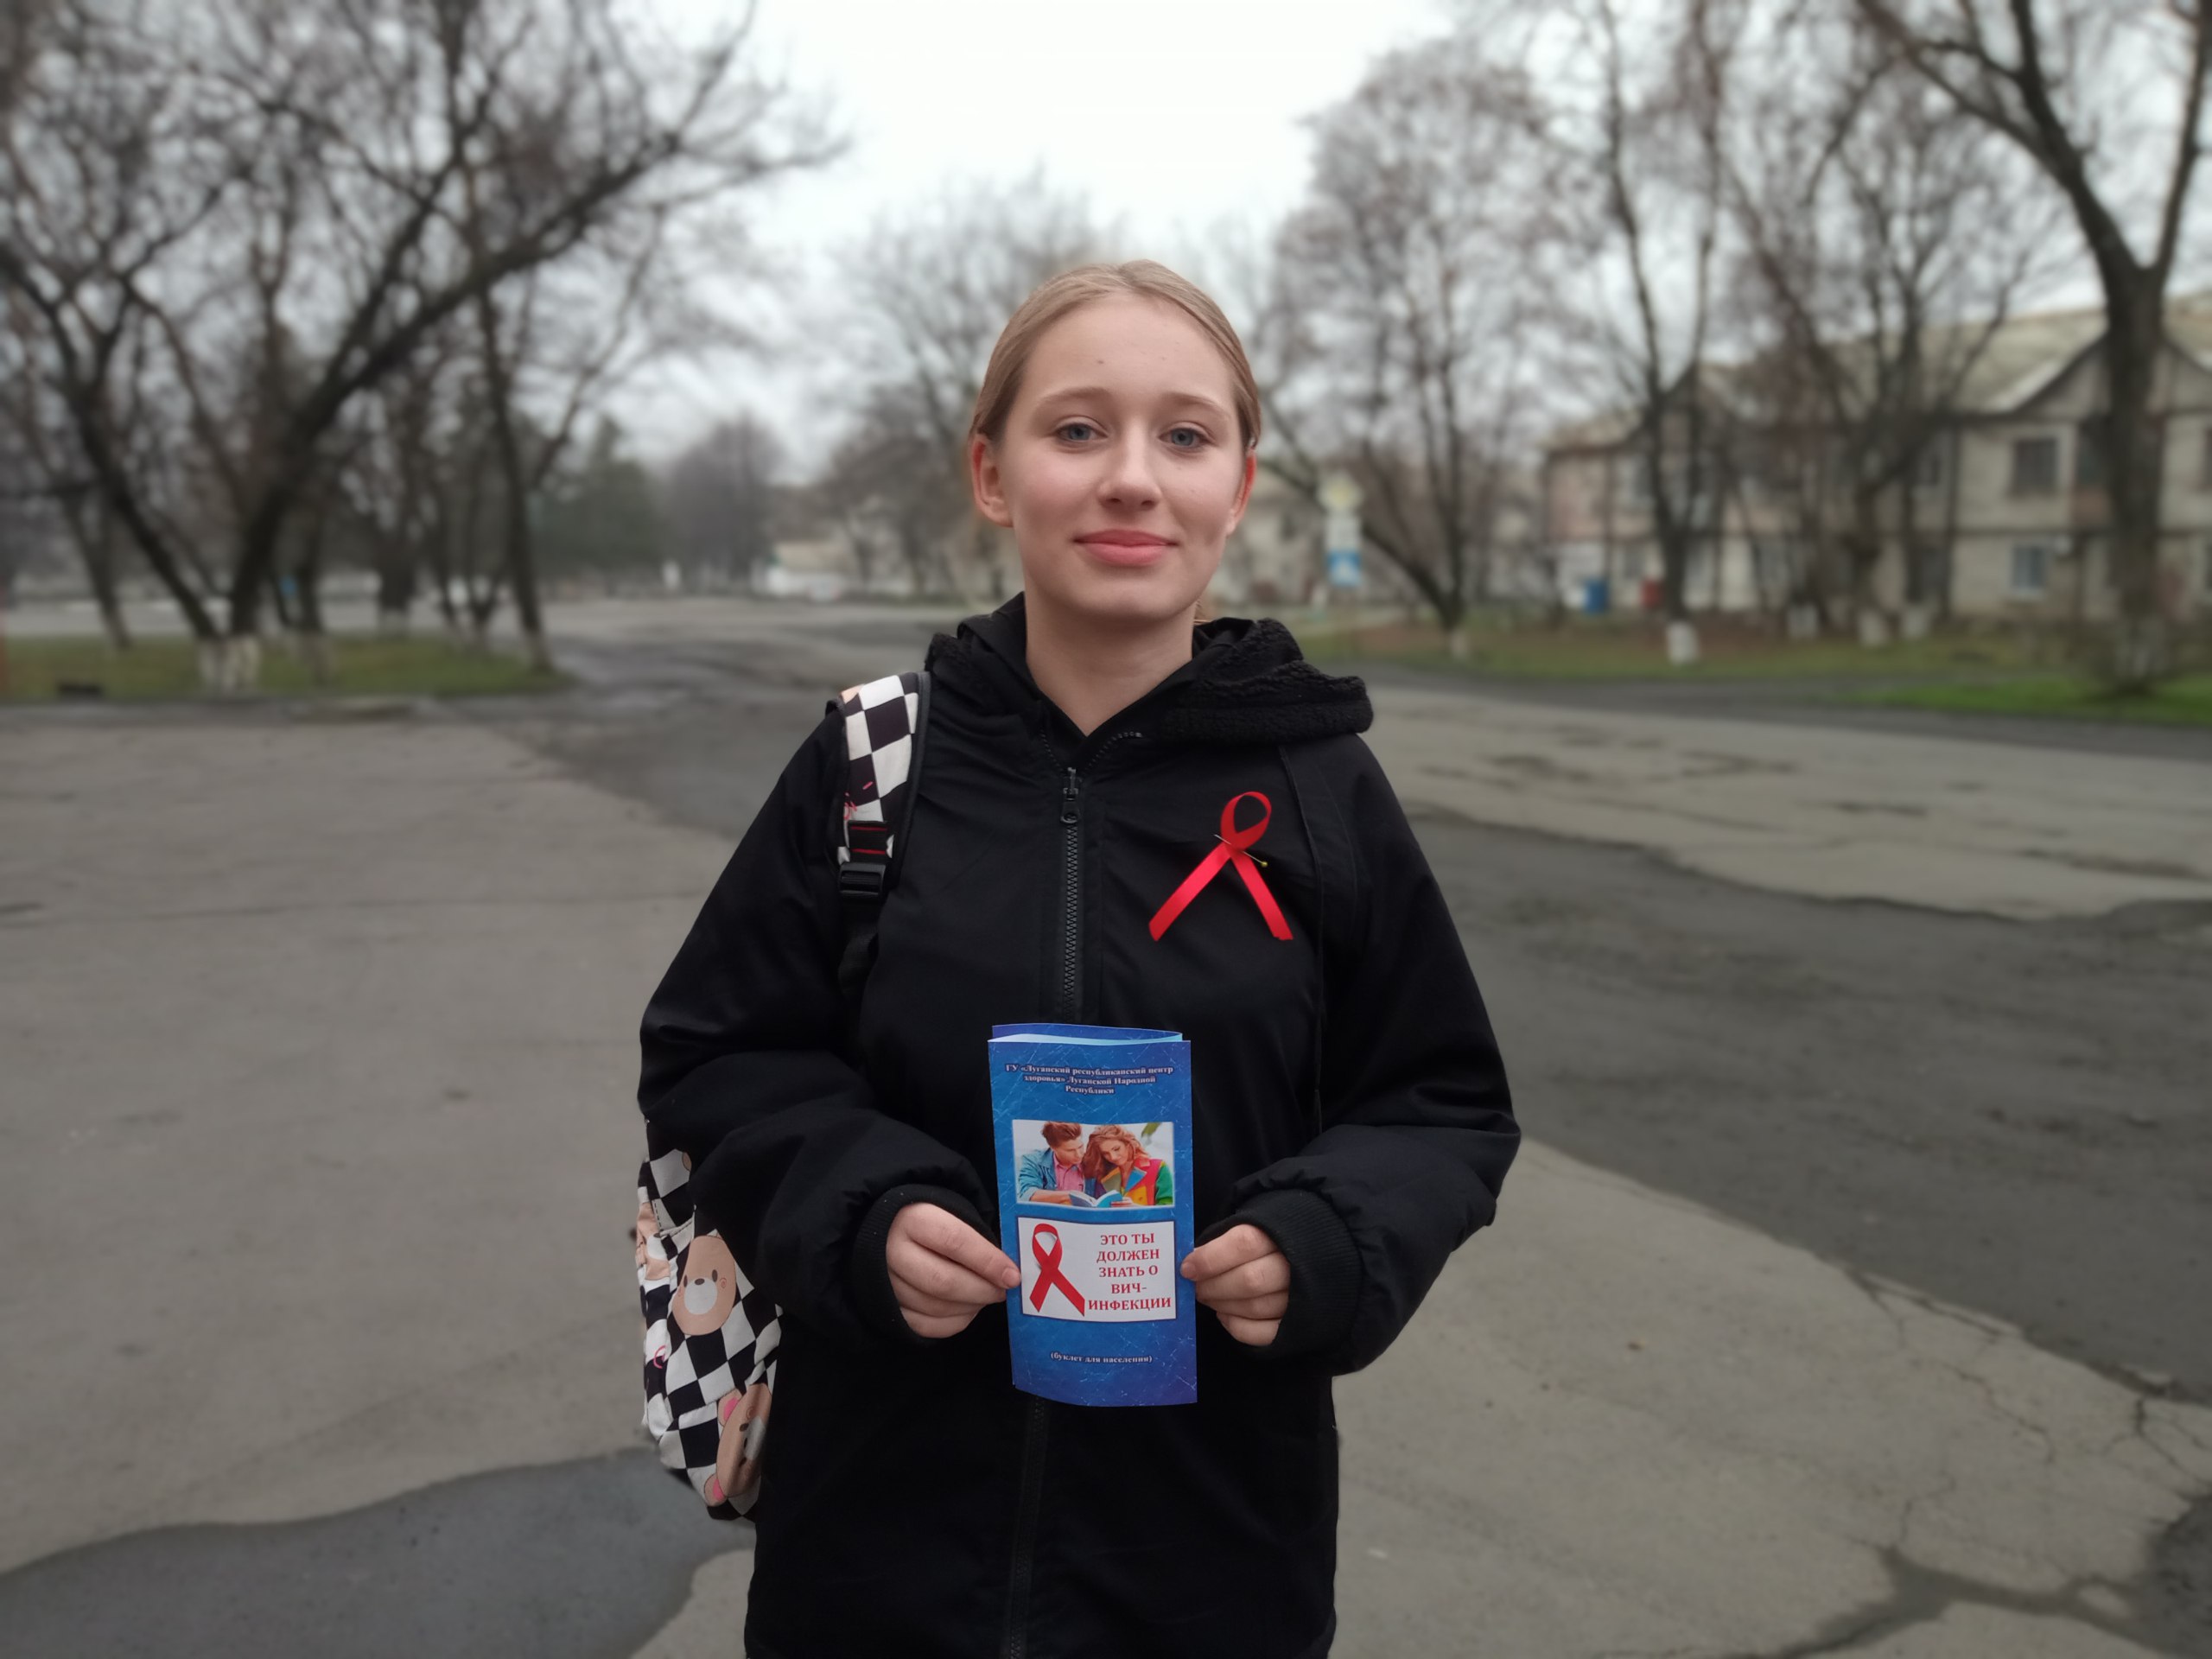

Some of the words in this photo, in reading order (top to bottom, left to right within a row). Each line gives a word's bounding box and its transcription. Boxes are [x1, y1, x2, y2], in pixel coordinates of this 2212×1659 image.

[1020, 1065, 1071, 1074] «Луганский
[1071, 1067, 1147, 1077] республиканский
[1147, 1066, 1173, 1075] центр
[1066, 1076, 1112, 1085] Луганской
[1114, 1075, 1156, 1086] Народной
[1065, 1085, 1115, 1095] Республики
[1100, 1234, 1128, 1246] ЭТО
[1131, 1233, 1155, 1244] ТЫ
[1096, 1249, 1160, 1263] ДОЛЖЕН
[1098, 1266, 1145, 1278] ЗНАТЬ
[1148, 1265, 1159, 1276] О
[1111, 1282, 1147, 1294] ВИЧ-
[1088, 1297, 1172, 1311] ИНФЕКЦИИ
[1050, 1351, 1083, 1363] (буклет
